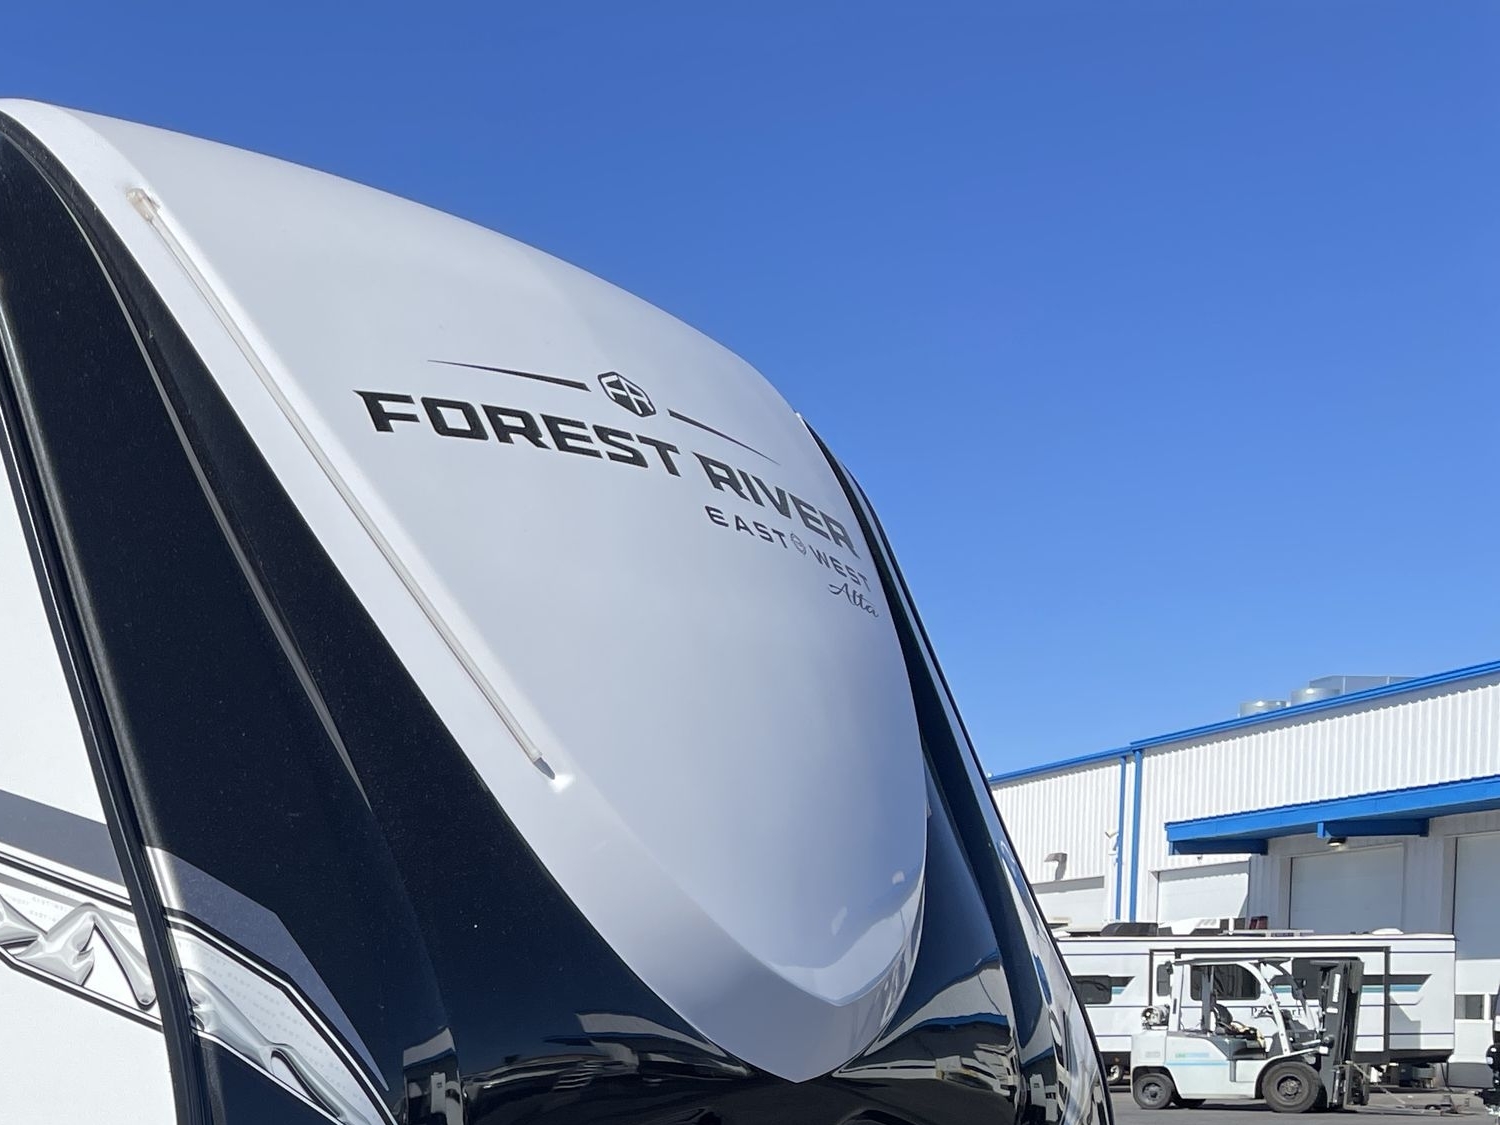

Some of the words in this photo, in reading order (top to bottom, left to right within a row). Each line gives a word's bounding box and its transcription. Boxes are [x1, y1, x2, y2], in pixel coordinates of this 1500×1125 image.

[353, 389, 682, 478] FOREST
[691, 450, 861, 560] RIVER
[704, 505, 789, 549] EAST
[808, 544, 872, 593] WEST
[828, 582, 880, 618] Alta
